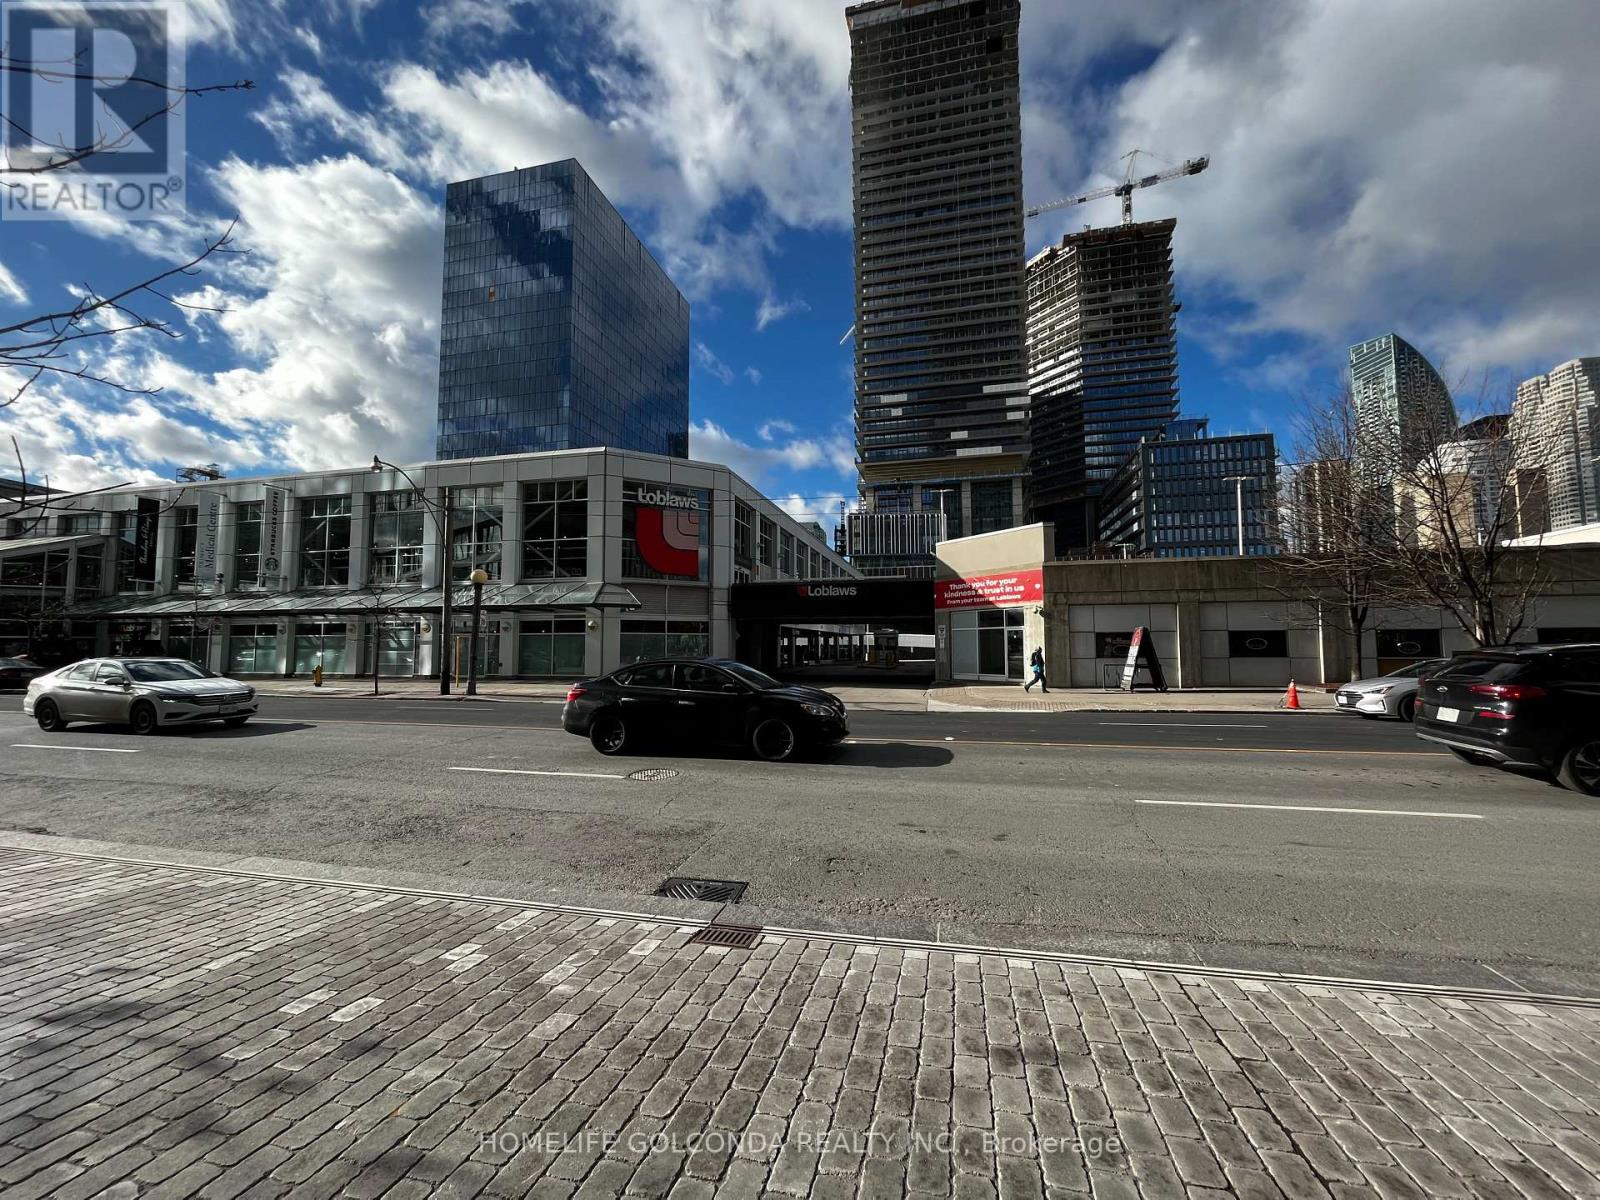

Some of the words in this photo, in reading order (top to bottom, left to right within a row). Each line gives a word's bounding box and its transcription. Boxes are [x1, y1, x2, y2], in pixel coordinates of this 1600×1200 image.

[638, 488, 699, 509] Loblaws
[206, 502, 218, 532] Centre
[204, 534, 216, 569] Medical
[808, 585, 857, 597] Loblaws
[971, 582, 985, 590] you
[999, 578, 1017, 586] your
[944, 590, 975, 598] kindness
